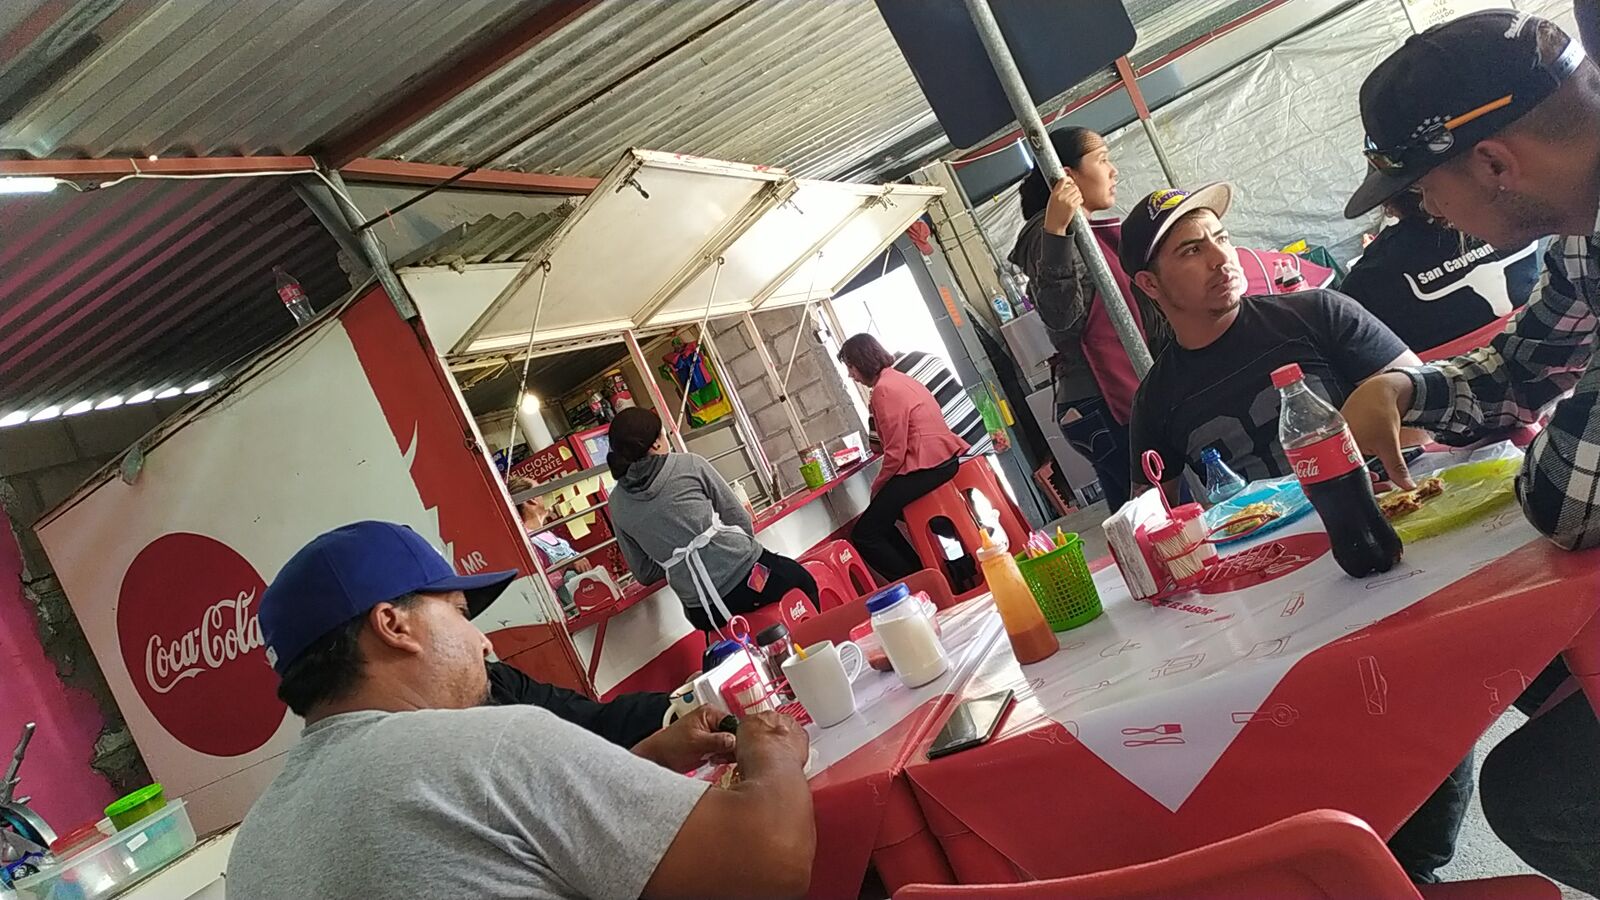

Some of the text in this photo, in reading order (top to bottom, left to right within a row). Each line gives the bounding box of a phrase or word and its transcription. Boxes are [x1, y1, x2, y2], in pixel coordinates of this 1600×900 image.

[1417, 243, 1495, 285] San Cayetan
[525, 458, 562, 480] ESCANTE
[460, 551, 488, 576] MR
[145, 586, 264, 693] Coca-Cola
